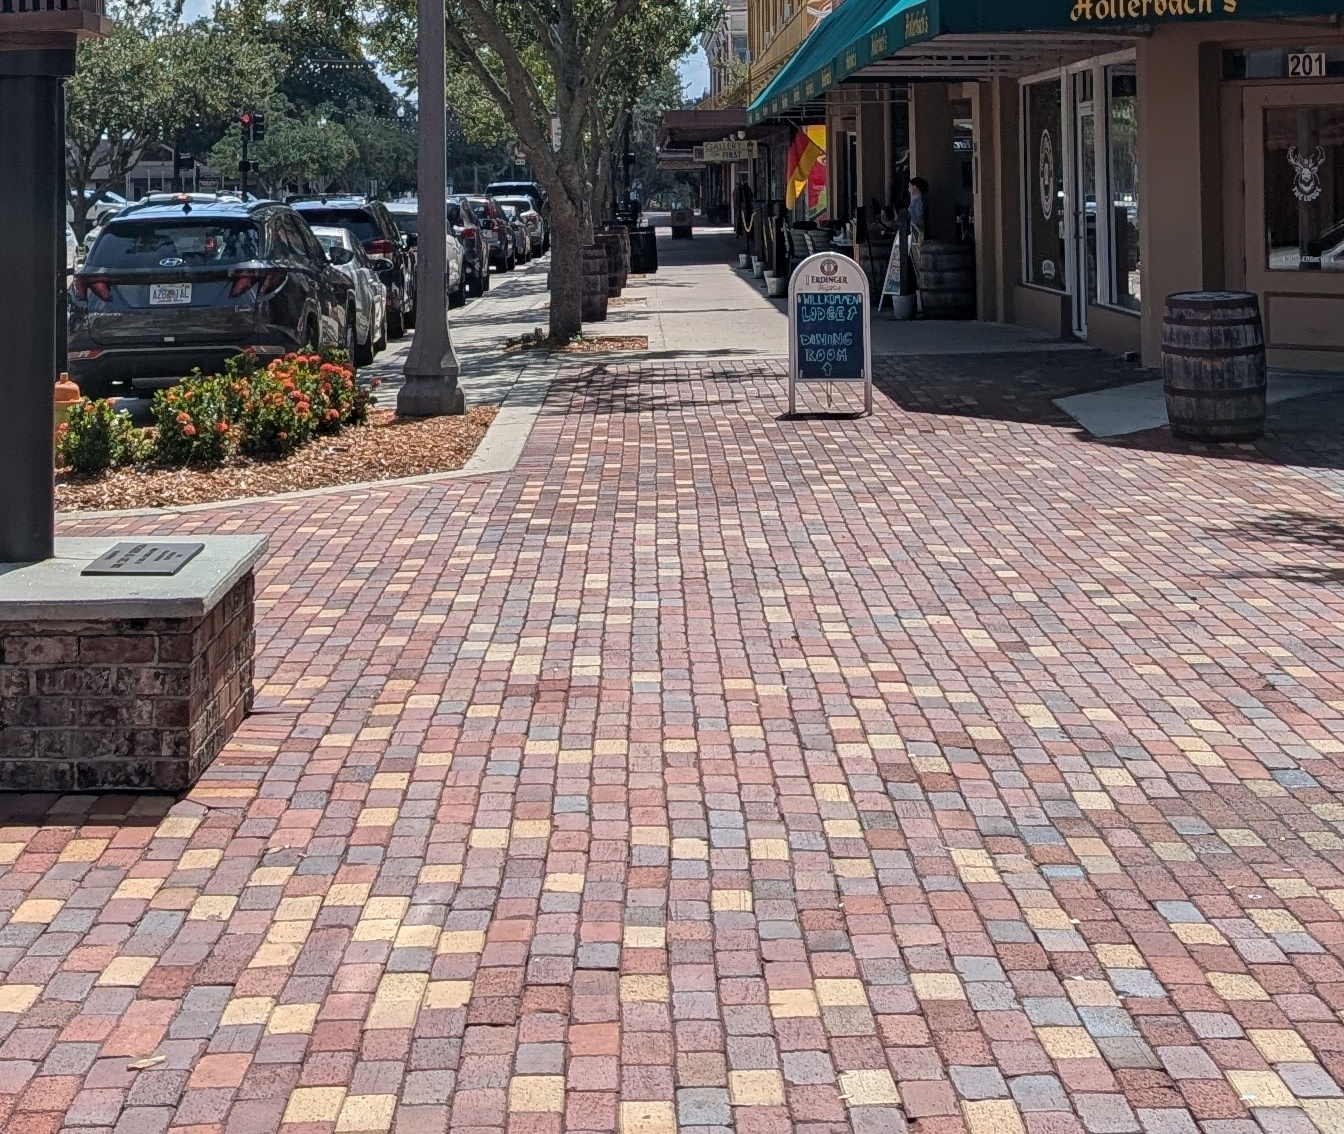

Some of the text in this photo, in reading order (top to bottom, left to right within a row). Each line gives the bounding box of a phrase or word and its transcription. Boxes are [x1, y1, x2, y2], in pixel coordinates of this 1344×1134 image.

[1290, 53, 1323, 76] 201
[722, 150, 742, 159] FIRST
[811, 275, 849, 285] ERDINGER
[801, 306, 846, 322] LODGE
[799, 331, 853, 346] DINING
[804, 347, 848, 362] ROOM
